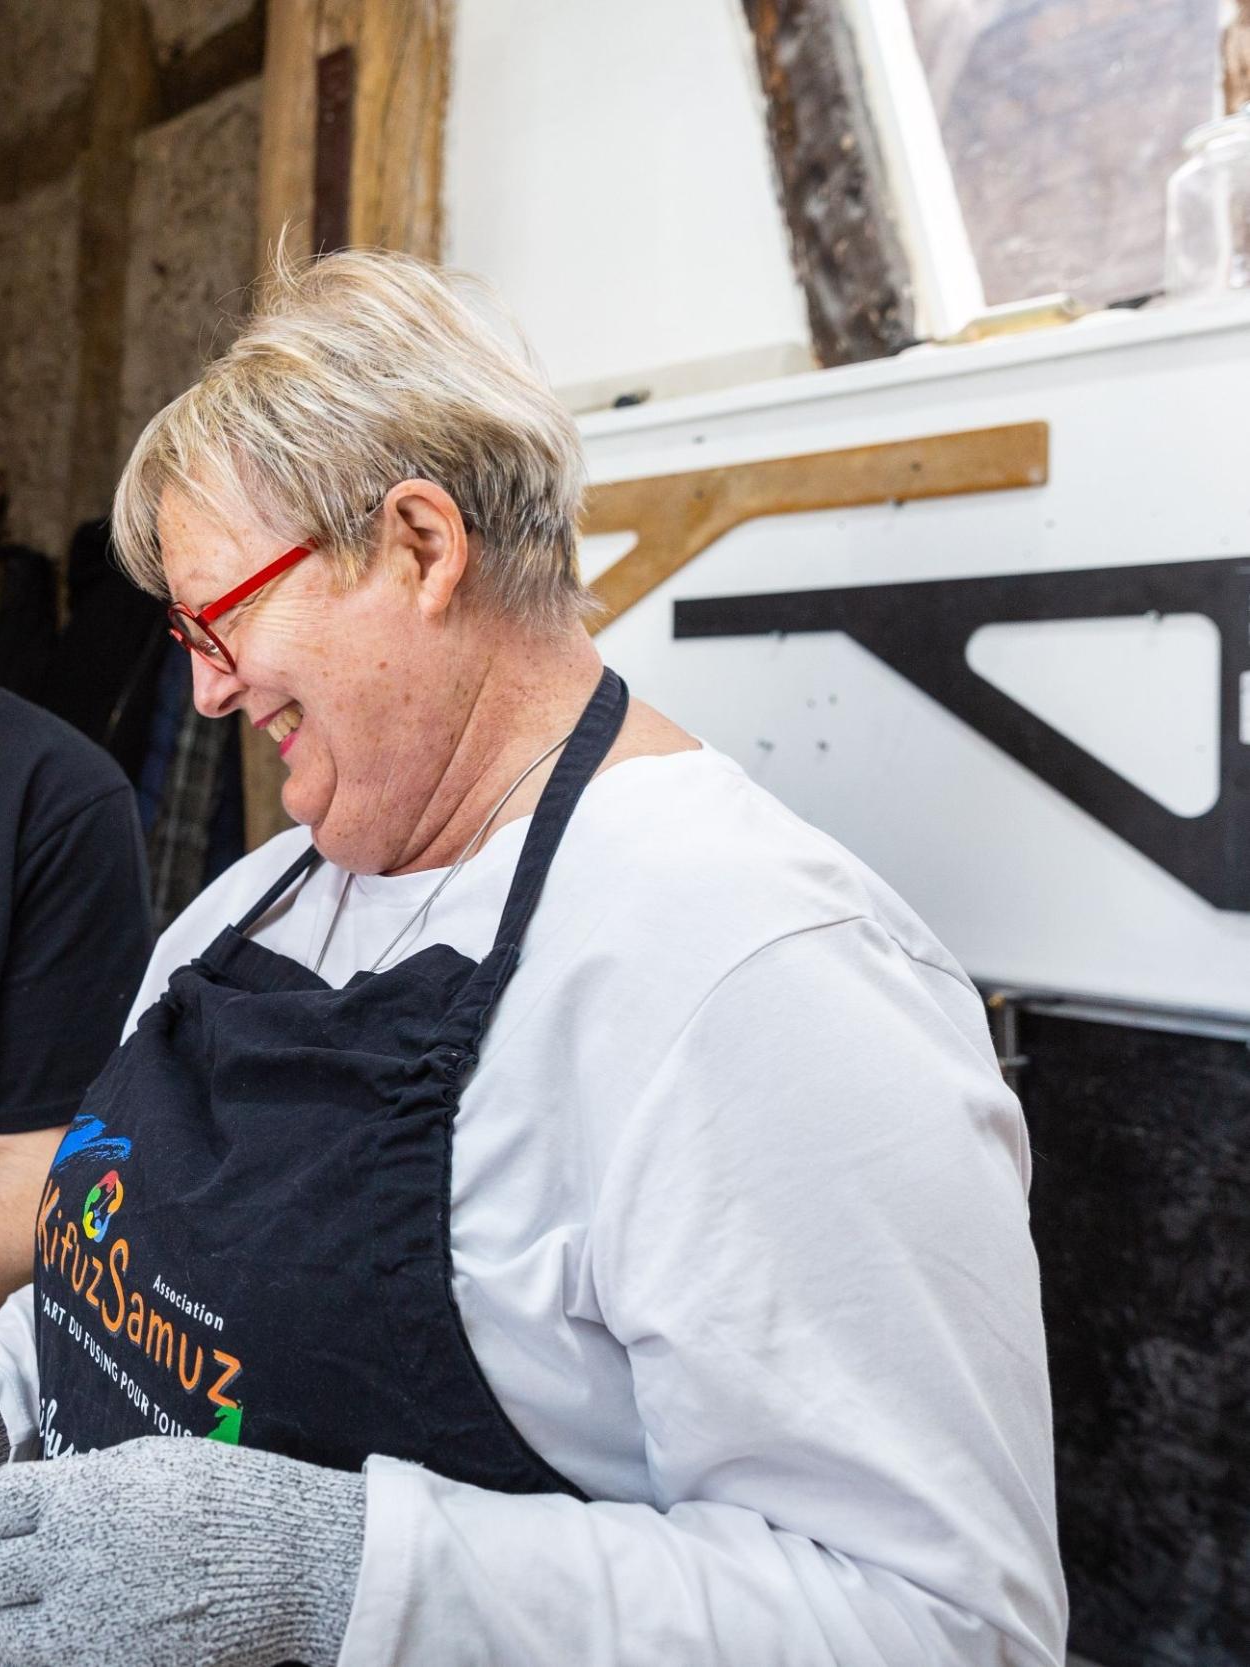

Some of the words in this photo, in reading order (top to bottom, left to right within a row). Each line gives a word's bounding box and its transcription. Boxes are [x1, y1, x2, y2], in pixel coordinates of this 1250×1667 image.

[152, 1273, 225, 1333] Association
[40, 1288, 66, 1326] 'ART
[68, 1315, 82, 1342] DU
[83, 1331, 118, 1382] FUSING
[120, 1370, 150, 1417] POUR
